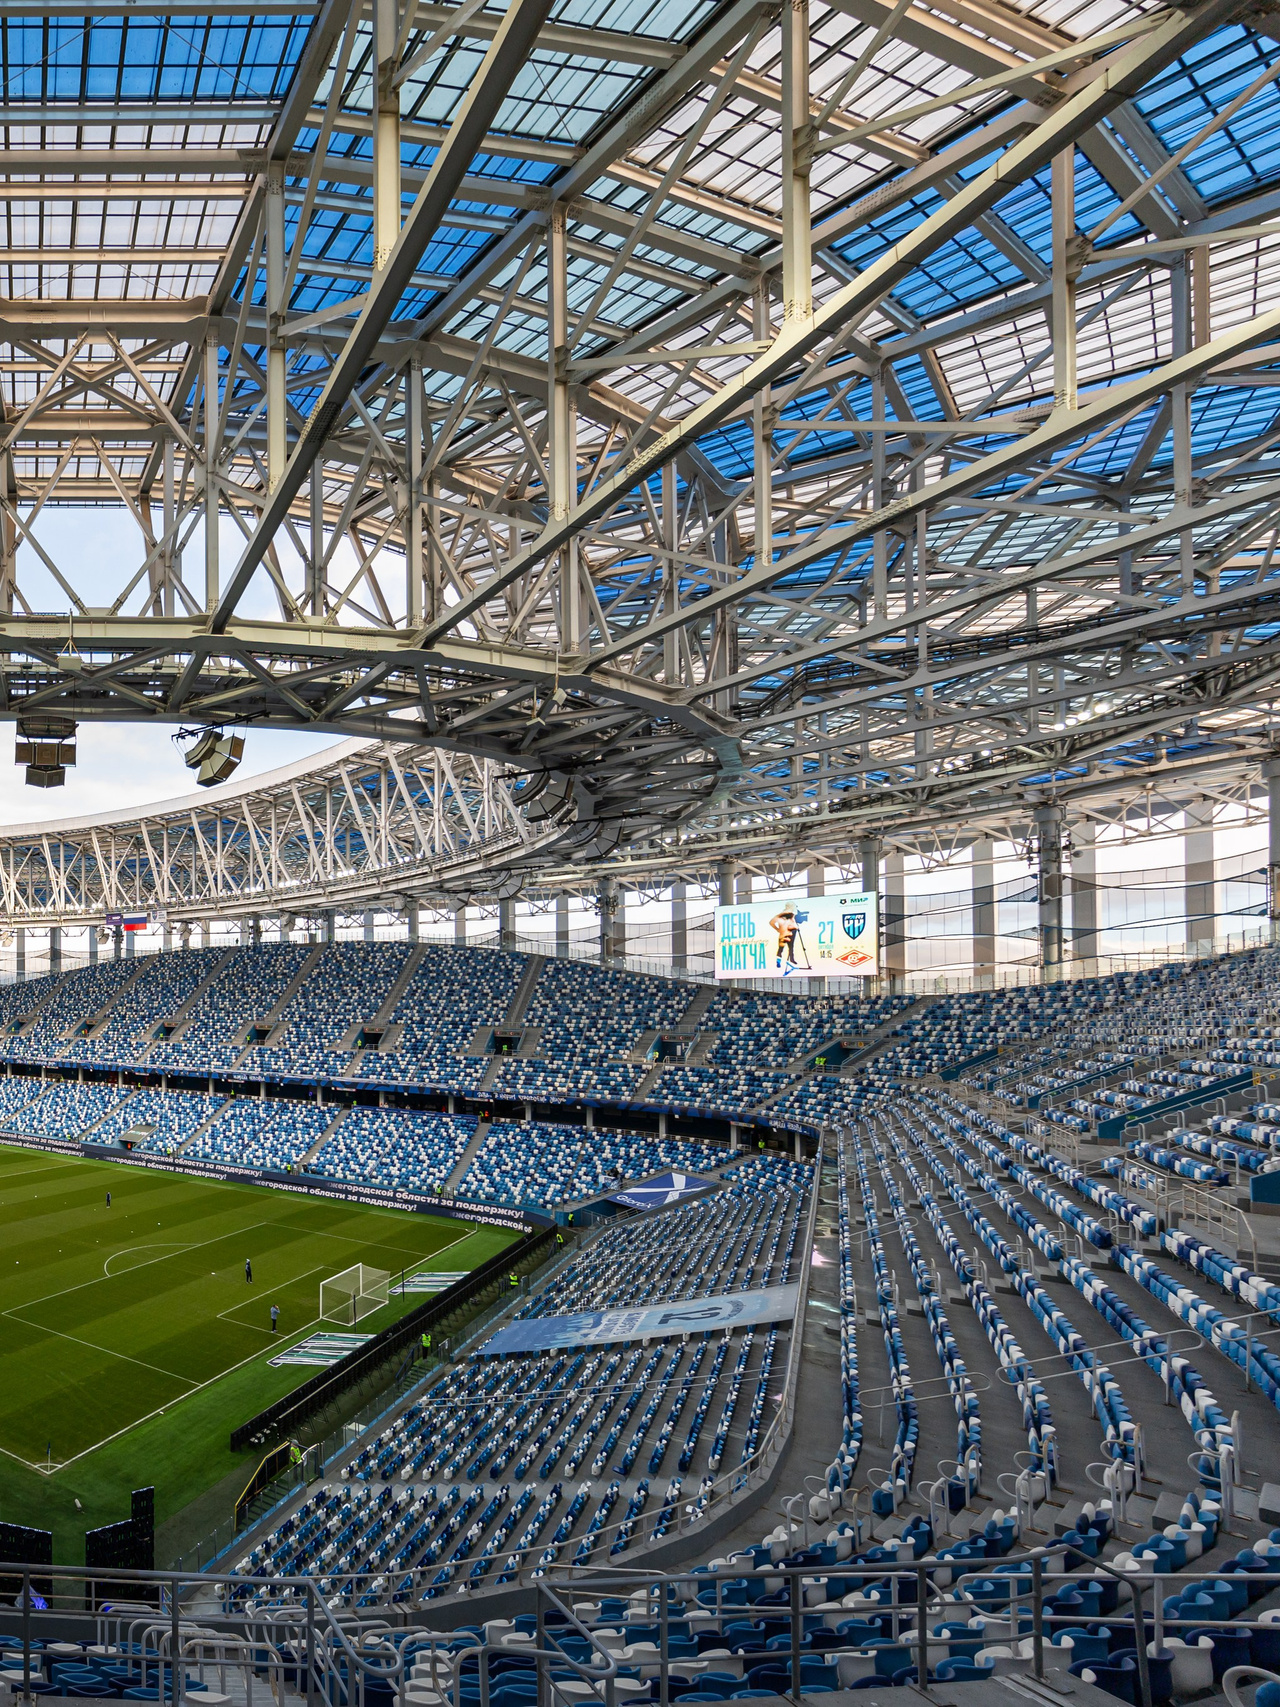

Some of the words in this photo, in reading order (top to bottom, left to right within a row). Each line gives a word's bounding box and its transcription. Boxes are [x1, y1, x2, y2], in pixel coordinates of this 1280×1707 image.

[721, 912, 755, 943] ДЕНЬ
[818, 920, 834, 944] 27
[721, 942, 766, 970] МАТЧА
[147, 1161, 174, 1171] области
[185, 1168, 227, 1180] поддержку!
[174, 1157, 203, 1167] области
[216, 1164, 263, 1178] поддержку!
[309, 1188, 345, 1200] области
[359, 1197, 417, 1212] поддержку!
[396, 1190, 438, 1204] области
[455, 1201, 524, 1220] поддержку!
